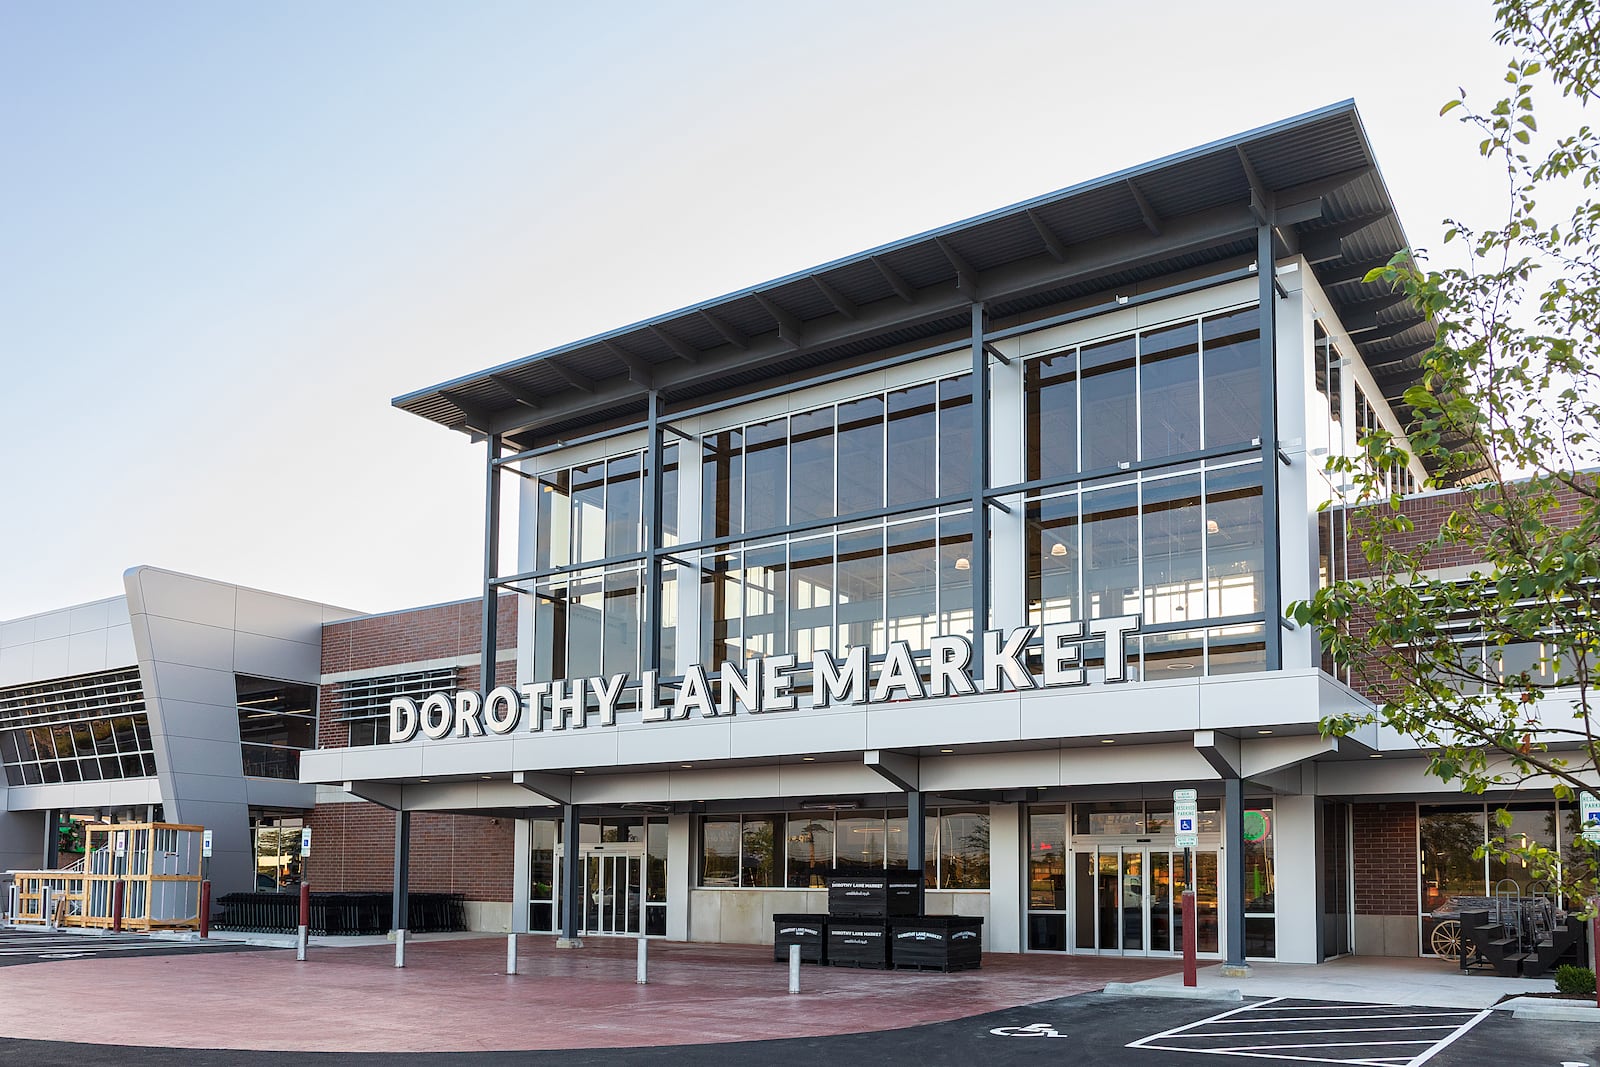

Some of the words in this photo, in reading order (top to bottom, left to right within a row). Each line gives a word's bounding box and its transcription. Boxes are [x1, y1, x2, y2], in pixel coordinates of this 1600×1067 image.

[389, 672, 629, 743] DOROTHY
[642, 653, 798, 723] LANE
[813, 614, 1141, 709] MARKET
